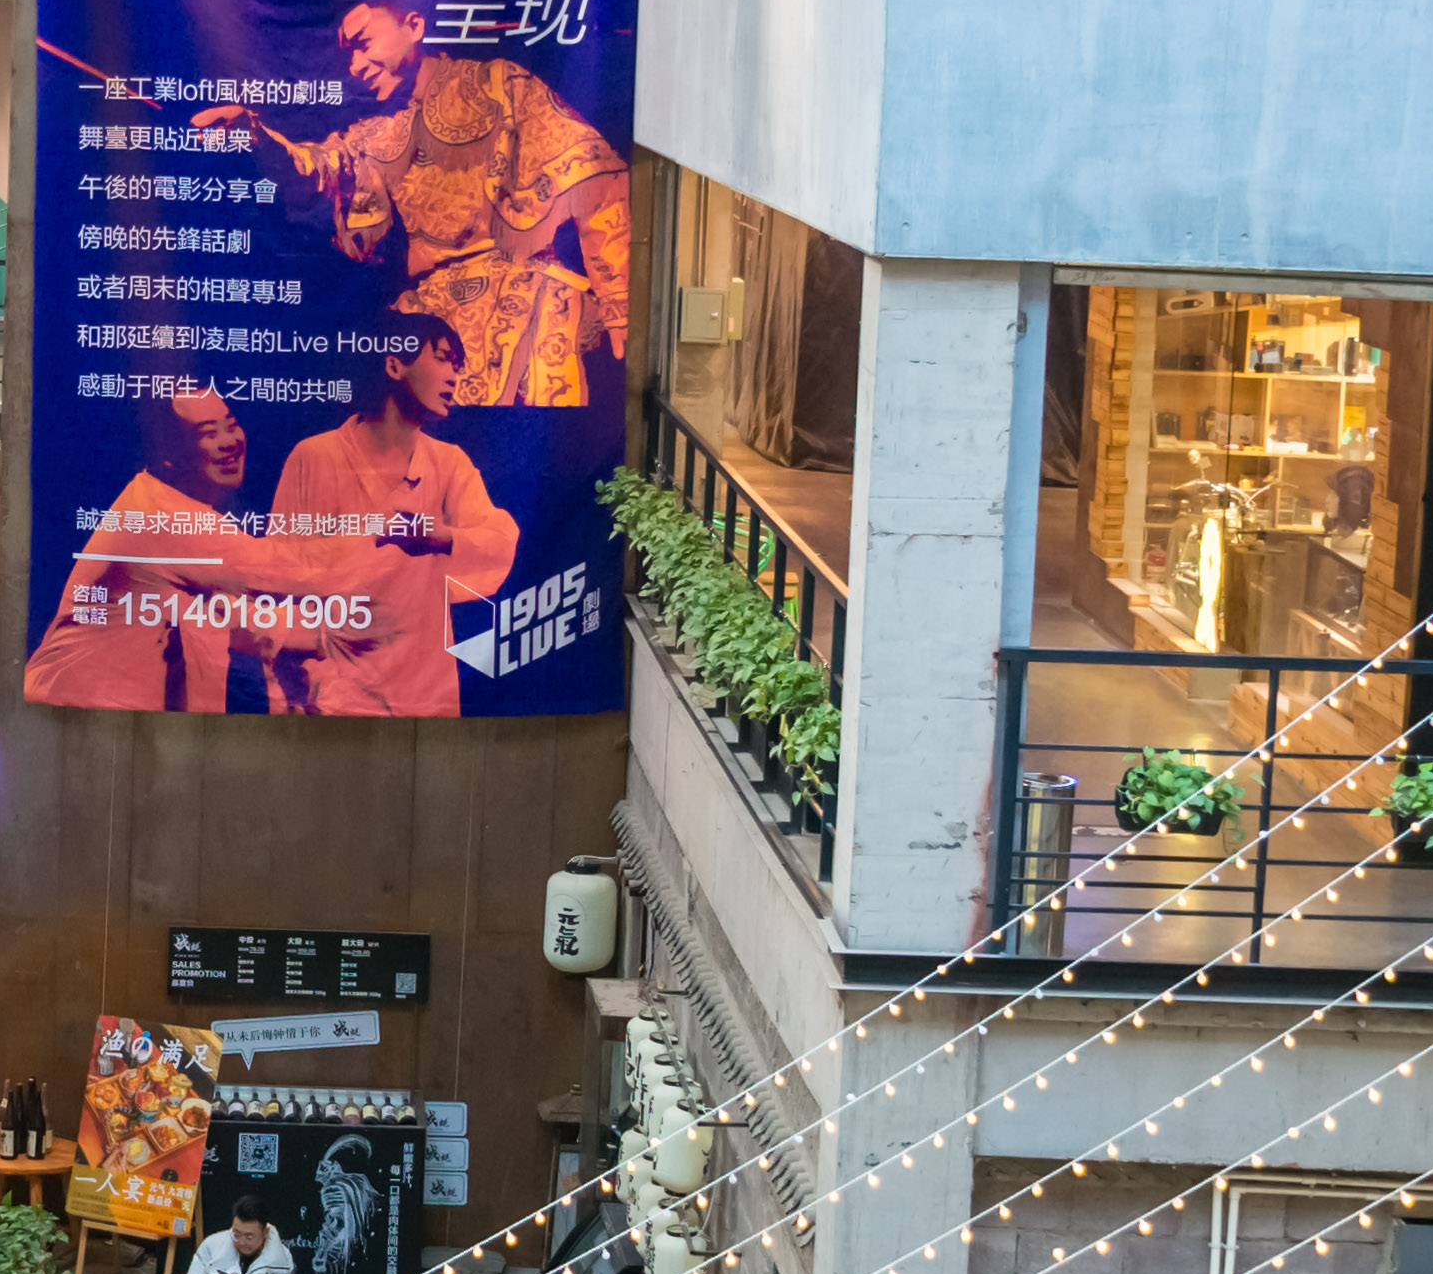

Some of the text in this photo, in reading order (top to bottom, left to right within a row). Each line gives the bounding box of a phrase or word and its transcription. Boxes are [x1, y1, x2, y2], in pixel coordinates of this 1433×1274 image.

[79, 75, 344, 106] 一座工業loft風格的劇場
[78, 175, 278, 204] 午後的電影分享會
[78, 224, 251, 255] 傍晚的先鋒話劇
[77, 275, 303, 305] 或者周末的相聲專場
[337, 330, 419, 354] House
[76, 506, 435, 539] 誠意尋求品牌合作及場地租賃合作
[116, 592, 373, 630] 15140181905
[500, 562, 586, 638] 1905
[72, 606, 108, 626] 電話
[499, 608, 576, 677] LIVE
[172, 961, 202, 969] SALES
[172, 970, 227, 978] PROMOTION
[75, 1173, 145, 1203] 一人宴
